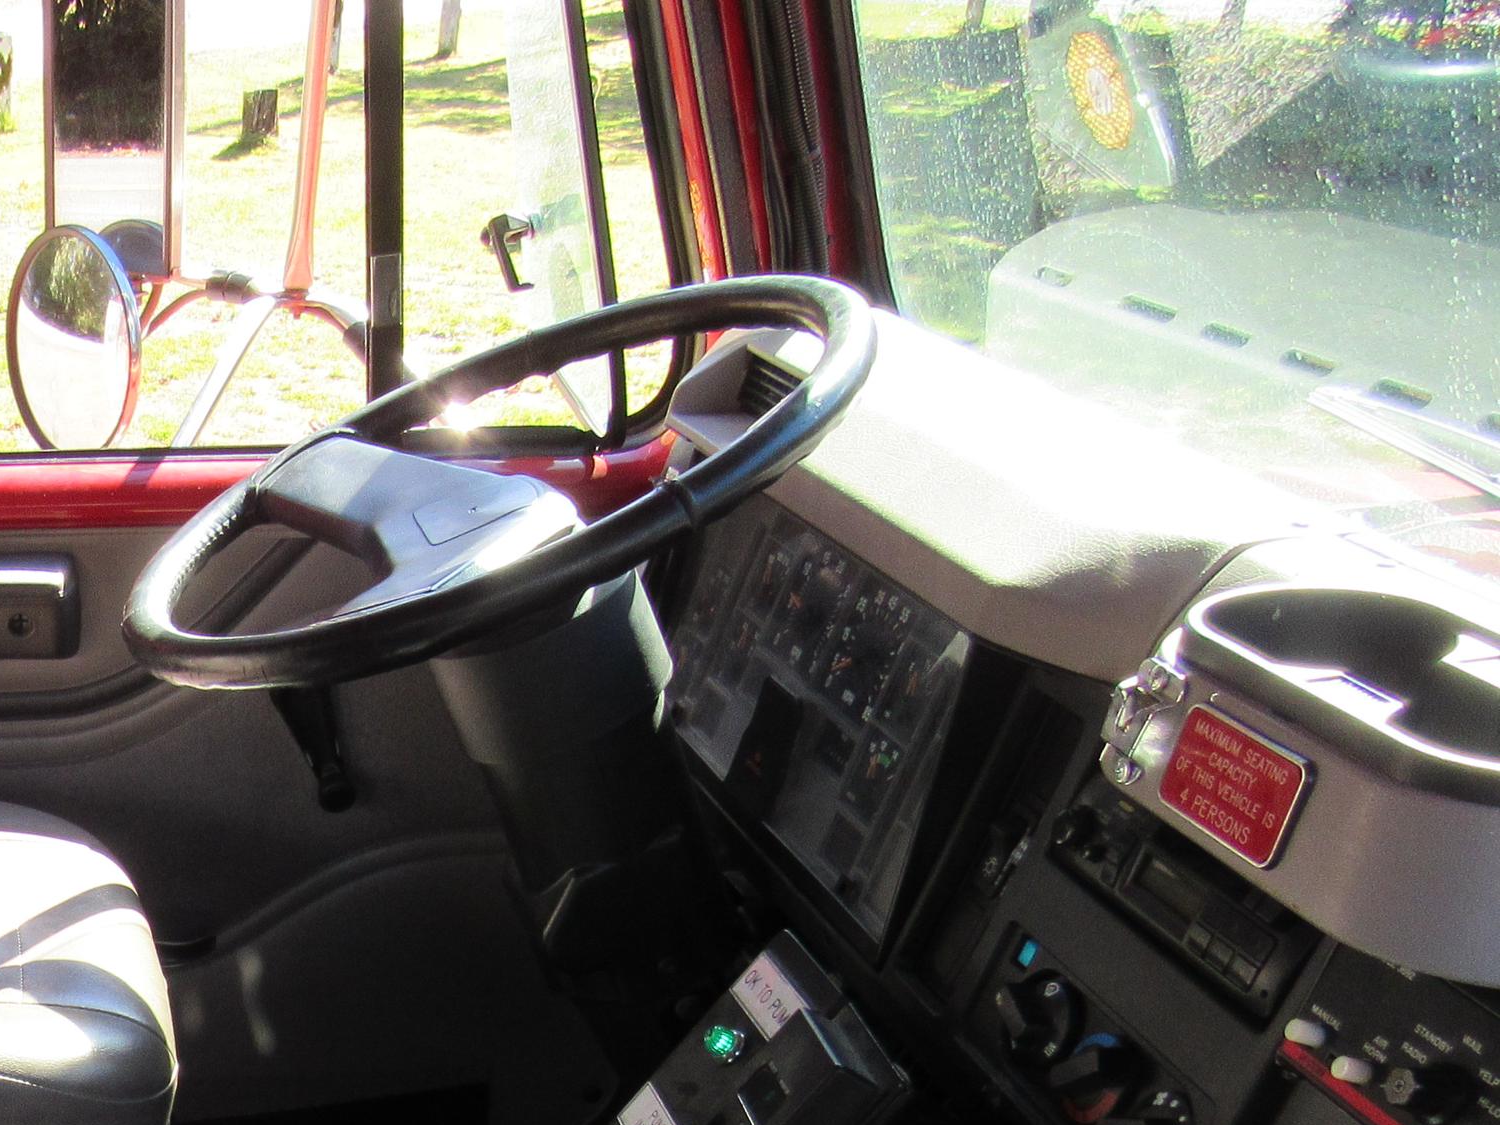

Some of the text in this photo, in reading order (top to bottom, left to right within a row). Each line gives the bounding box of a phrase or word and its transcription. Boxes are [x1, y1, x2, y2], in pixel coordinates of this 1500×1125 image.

[1194, 718, 1289, 786] MAXIMUM SEATING
[1208, 752, 1257, 789] CAPACITY
[1176, 756, 1276, 829] OF THIS VEHICLE IS
[1179, 788, 1250, 845] 4 PERSONS
[744, 969, 763, 989] OK
[759, 984, 773, 1004] TO
[1312, 1003, 1341, 1031] MANUAL
[1401, 1041, 1428, 1065] RADIO
[1414, 1023, 1452, 1054] STANDBY
[1462, 1034, 1483, 1055] WAIL
